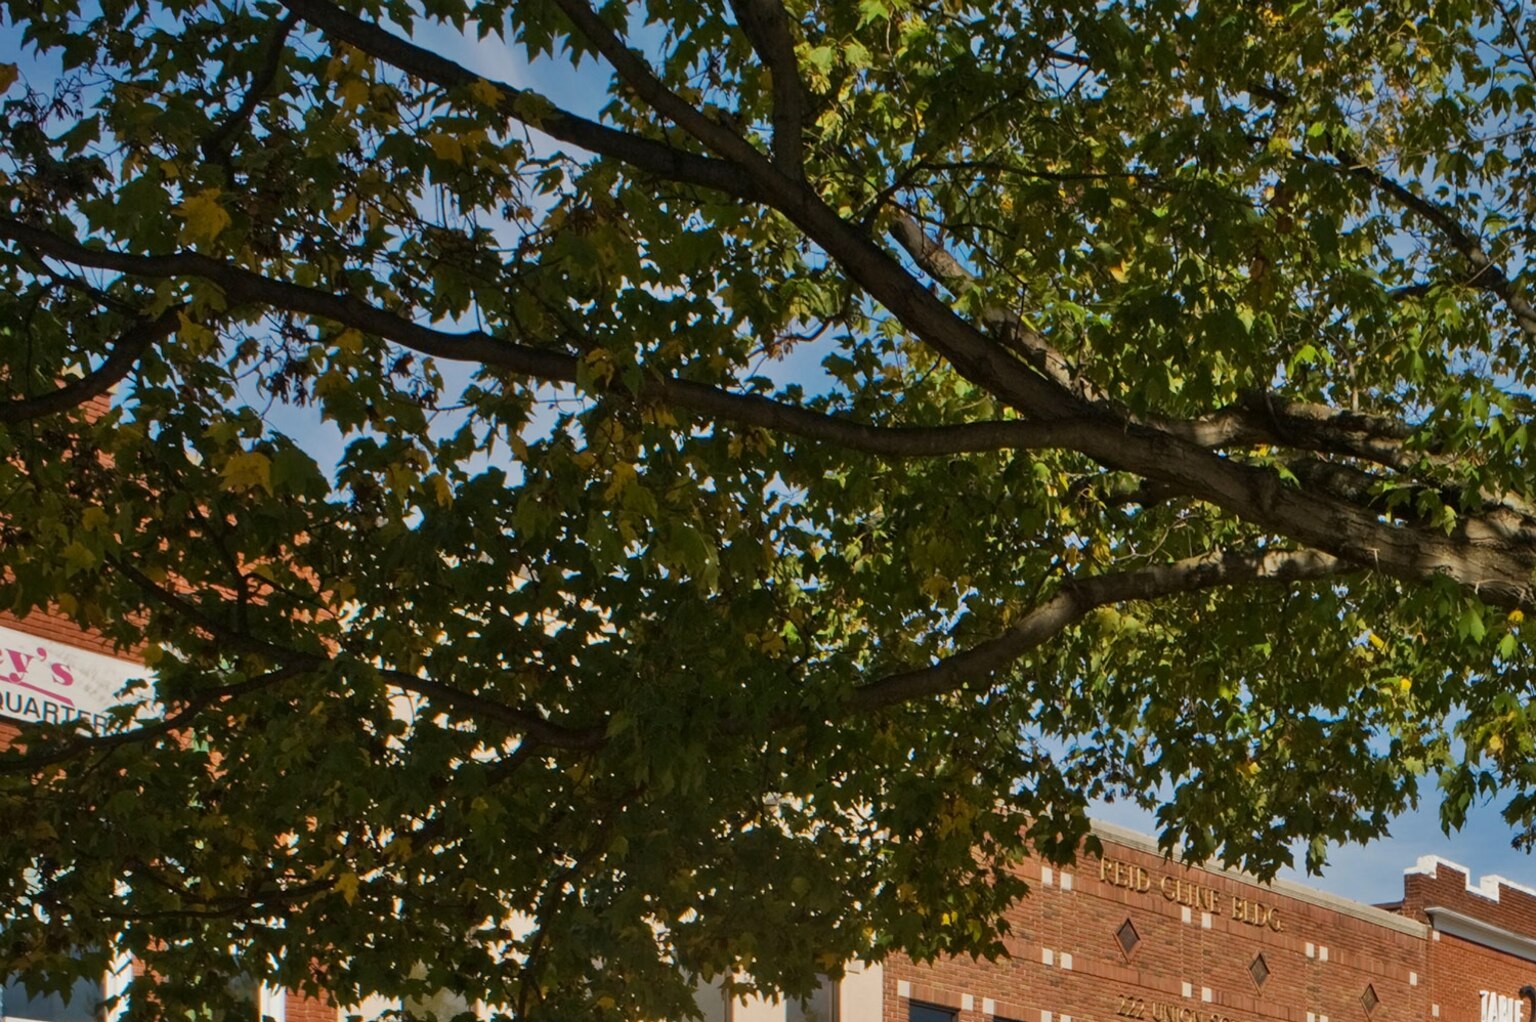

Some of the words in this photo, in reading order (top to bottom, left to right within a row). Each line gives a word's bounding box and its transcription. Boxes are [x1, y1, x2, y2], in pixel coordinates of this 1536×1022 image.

[1100, 856, 1150, 893] REID
[1160, 876, 1222, 915] CLINE
[1116, 994, 1145, 1020] 222
